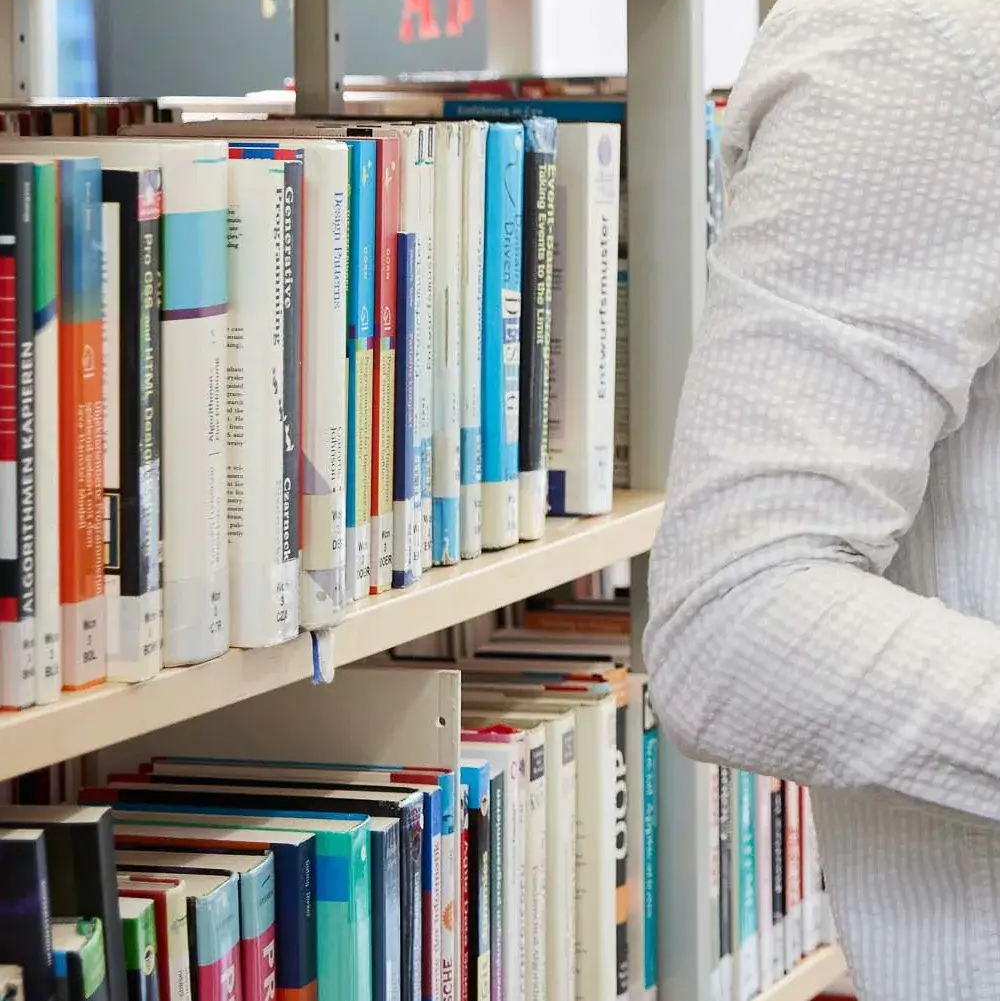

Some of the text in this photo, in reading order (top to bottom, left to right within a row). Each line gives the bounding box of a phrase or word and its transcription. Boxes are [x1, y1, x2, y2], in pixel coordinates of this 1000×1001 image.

[144, 233, 154, 265] Pro
[272, 187, 283, 346] Programming
[284, 185, 294, 310] Generative
[333, 191, 344, 310] Design Patterns
[503, 221, 515, 284] Driven
[535, 162, 547, 345] Taking Events to the Limit
[545, 163, 557, 303] Event-Based
[144, 314, 152, 343] and
[597, 214, 610, 401] Entwurfsmuster
[143, 347, 154, 399] HTML
[86, 401, 95, 451] spielend
[94, 400, 104, 501] Objektorientierte
[144, 404, 155, 470] Design
[20, 340, 35, 614] ALGORITHMEN KAPIEREN
[85, 452, 94, 497] gelernt
[85, 521, 93, 549] dem
[82, 650, 98, 664] BOL
[431, 843, 441, 924] Informatik
[494, 787, 502, 907] programmieren
